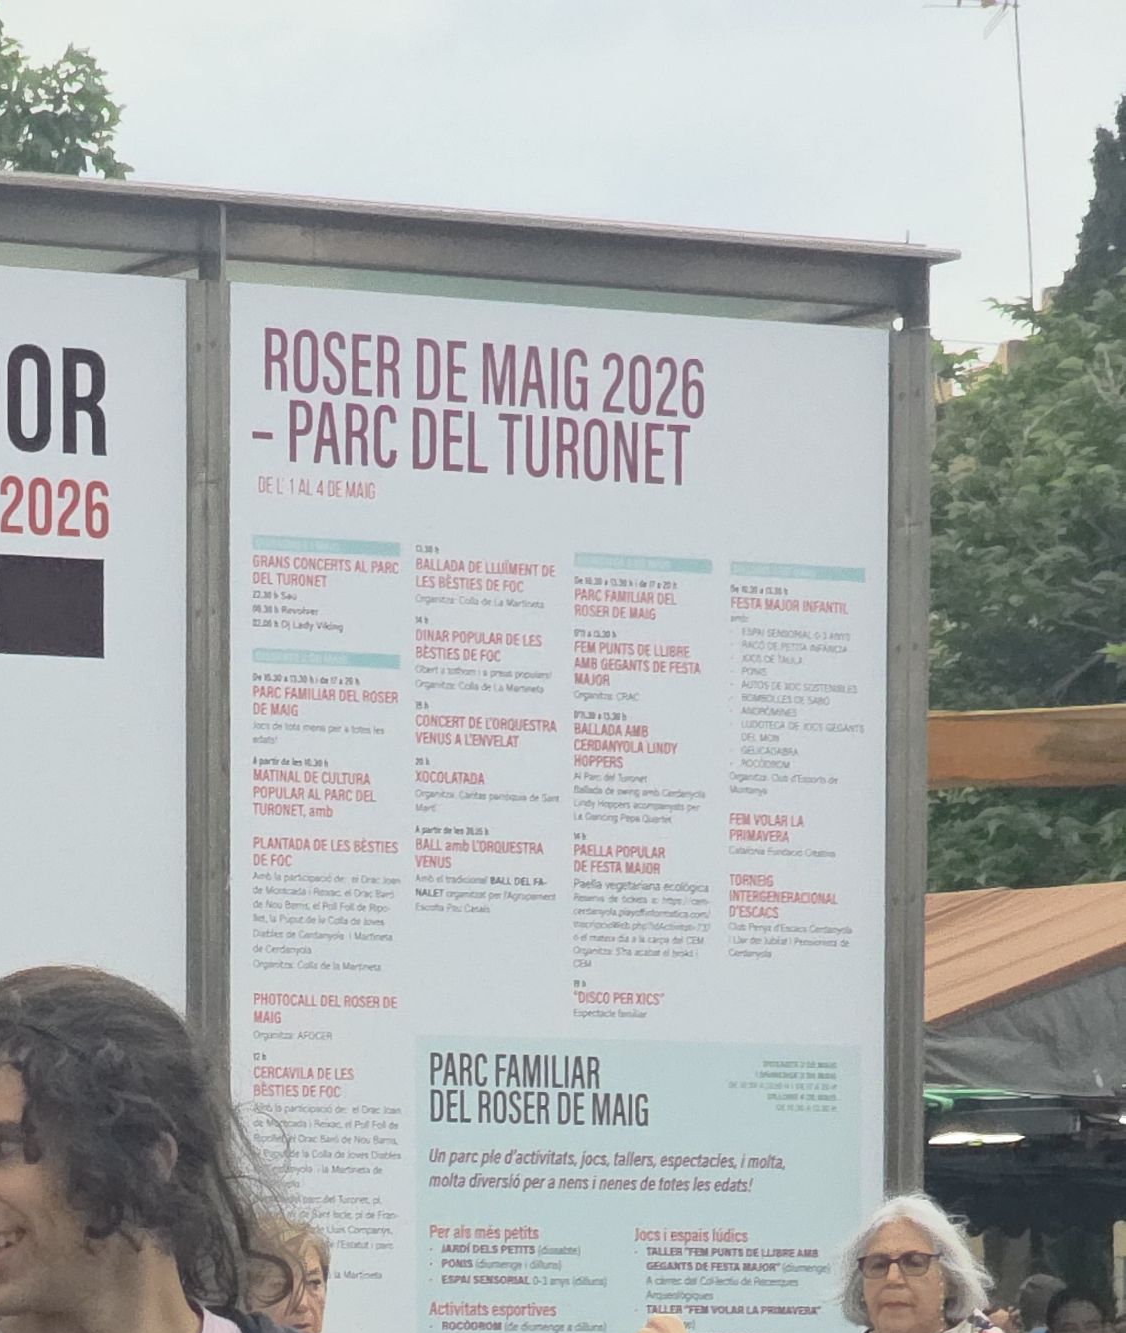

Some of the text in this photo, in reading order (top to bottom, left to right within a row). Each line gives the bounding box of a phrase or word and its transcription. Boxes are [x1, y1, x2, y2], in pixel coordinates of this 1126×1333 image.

[264, 327, 705, 420] ROSER DE MAIG 2026
[289, 399, 398, 469] PARC
[412, 406, 489, 474] DEL
[498, 412, 691, 486] TURONET
[257, 475, 273, 494] DE
[289, 478, 294, 495] 1
[298, 478, 313, 496] AL
[316, 479, 324, 496] 4
[327, 479, 342, 498] DE
[345, 480, 376, 500] MAIG
[0, 475, 110, 540] 2026
[252, 554, 399, 575] GRANS CONCERTS AL PARC
[252, 572, 327, 588] DEL TURONET
[415, 629, 542, 647] DINAR POPULAR DE LES
[415, 645, 460, 661] BÈSTIES
[462, 648, 478, 662] DE
[479, 648, 501, 663] FOC
[573, 722, 649, 738] BALLADA AMB
[573, 738, 678, 755] CERDANYOLA LINDY
[573, 754, 624, 769] HOPPERS
[253, 768, 371, 786] MATINAL DE CULTURA
[415, 770, 485, 785] XOCOLATADA
[252, 785, 377, 803] POPULAR AL PARC DEL
[252, 802, 334, 818] TURONET, amb
[729, 812, 804, 828] FEM VOLAR LA
[729, 828, 790, 843] PRIMAVERA
[415, 837, 544, 855] BALL amb L'ORQUESTRA
[573, 843, 666, 859] PAELLA POPULAR
[415, 855, 452, 869] VENUS
[573, 859, 661, 875] DE FESTA MAJOR
[253, 992, 398, 1009] PHOTOCALL DEL ROSER DE
[253, 1010, 282, 1025] MAIG
[429, 1052, 600, 1090] PARC FAMILIAR
[430, 1088, 649, 1127] DEL ROSER DE MAIG
[429, 1149, 446, 1163] Un
[448, 1151, 479, 1167] parc
[480, 1149, 502, 1167] ple
[504, 1149, 577, 1167] d'activitats,
[579, 1151, 610, 1168] jocs,
[613, 1151, 656, 1168] tallers,
[660, 1153, 737, 1170] espectacles,
[740, 1153, 747, 1169] i
[429, 1173, 754, 1193] molta diversió per a nens i nenes de totes les edats!
[429, 1224, 540, 1243] Per als més petits
[634, 1227, 749, 1245] Jocs i espais lúdics
[428, 1301, 557, 1318] Activitats esportives
